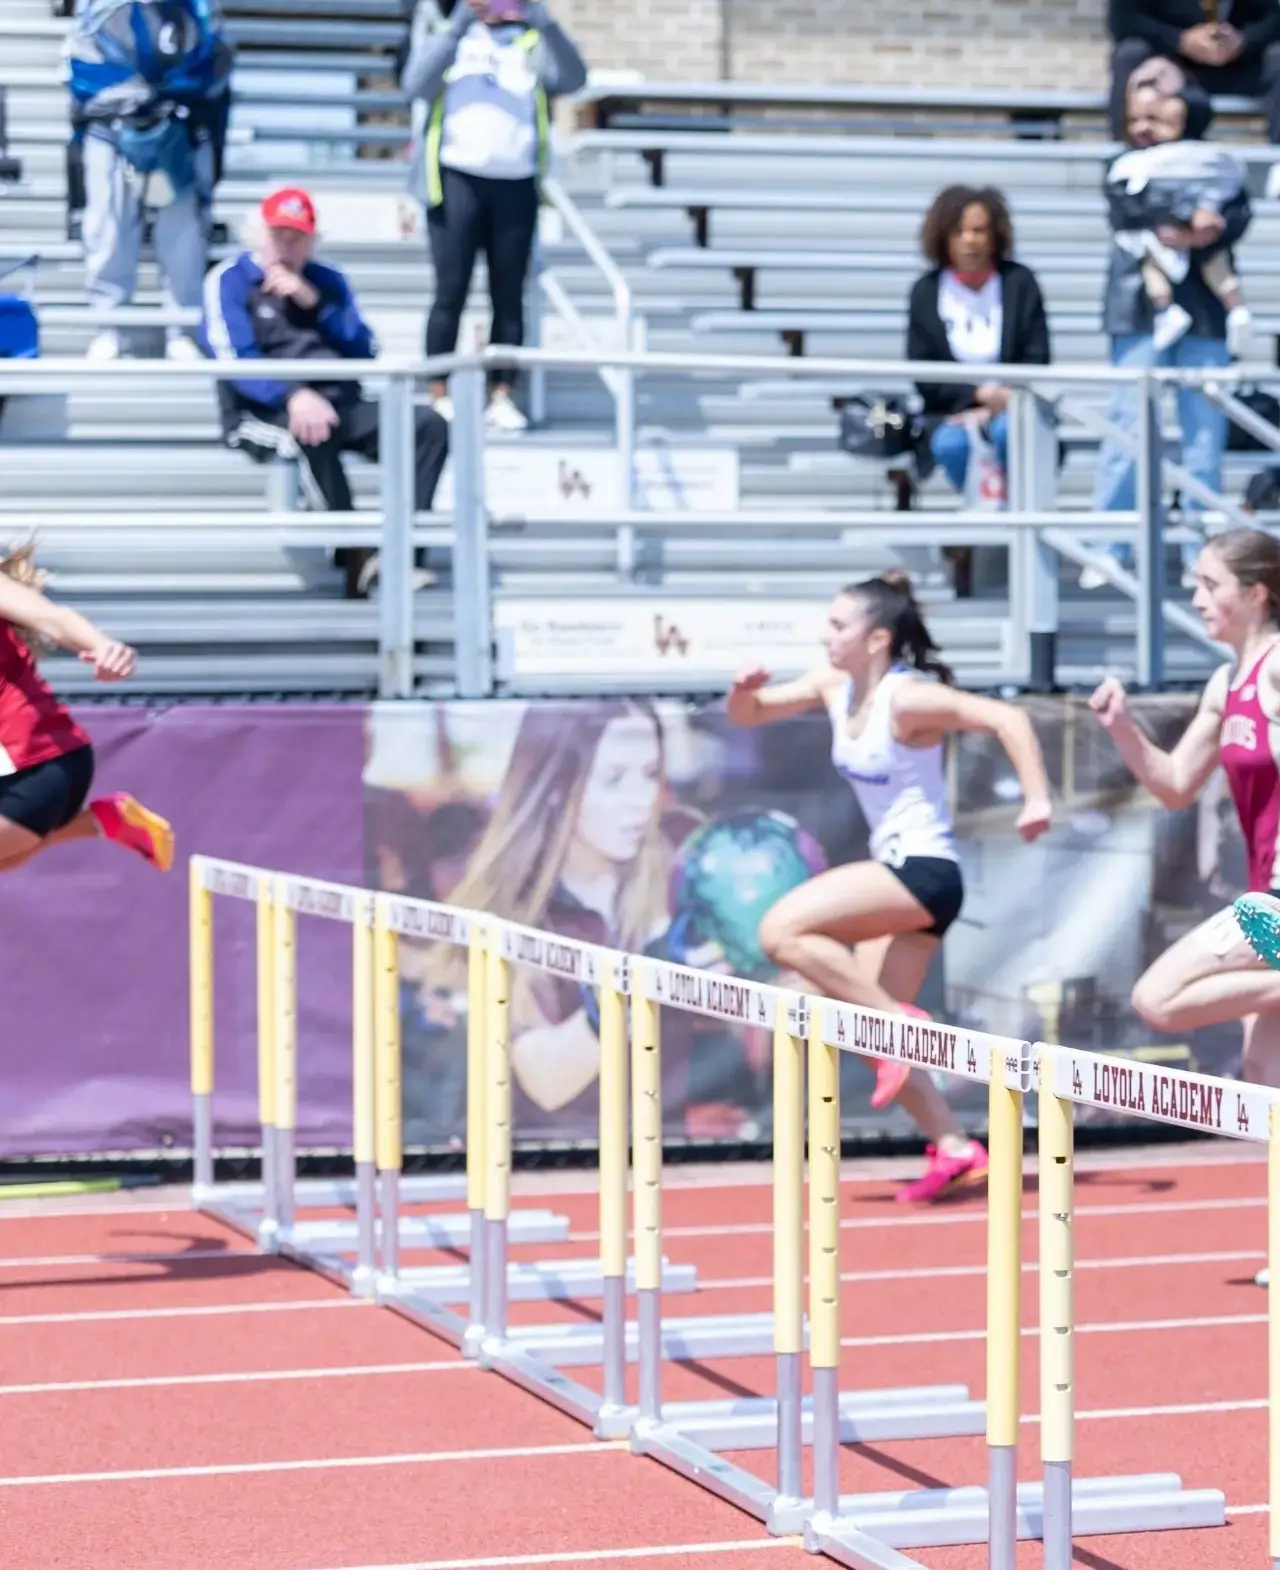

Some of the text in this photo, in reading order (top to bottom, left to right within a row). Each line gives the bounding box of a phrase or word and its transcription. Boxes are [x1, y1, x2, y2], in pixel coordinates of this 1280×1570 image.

[853, 1012, 895, 1055] LOYOLA
[899, 1023, 956, 1070] ACADEMY
[967, 1039, 976, 1073] LA
[1072, 1060, 1249, 1133] LA LOYOLA ACADEMY LA
